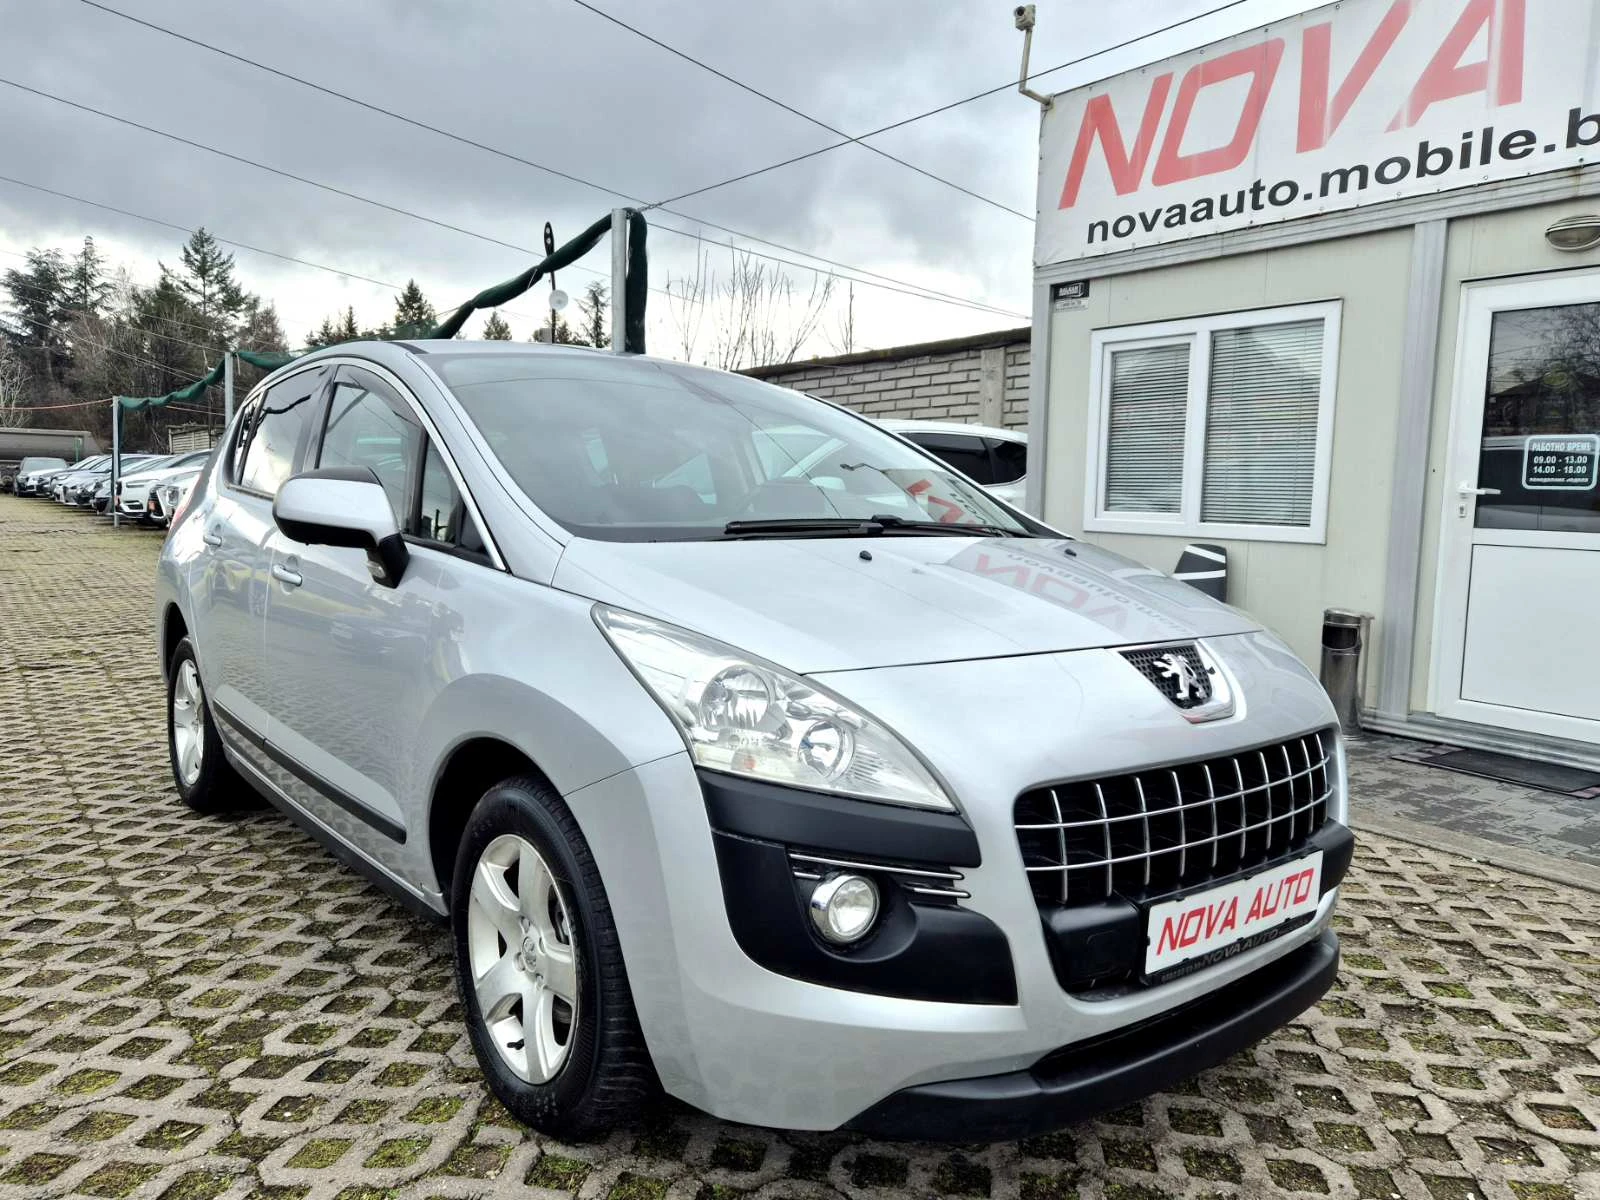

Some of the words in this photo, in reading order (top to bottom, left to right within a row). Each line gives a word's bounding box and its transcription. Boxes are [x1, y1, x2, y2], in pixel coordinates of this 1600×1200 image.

[1058, 0, 1524, 209] NOVA
[1087, 108, 1600, 243] novaauto.mobile.b
[1533, 455, 1557, 464] 09.00
[1565, 455, 1588, 464] 13.00
[1533, 465, 1556, 474] 14.00
[1157, 896, 1239, 955] NOVA
[1245, 868, 1314, 924] AUTO
